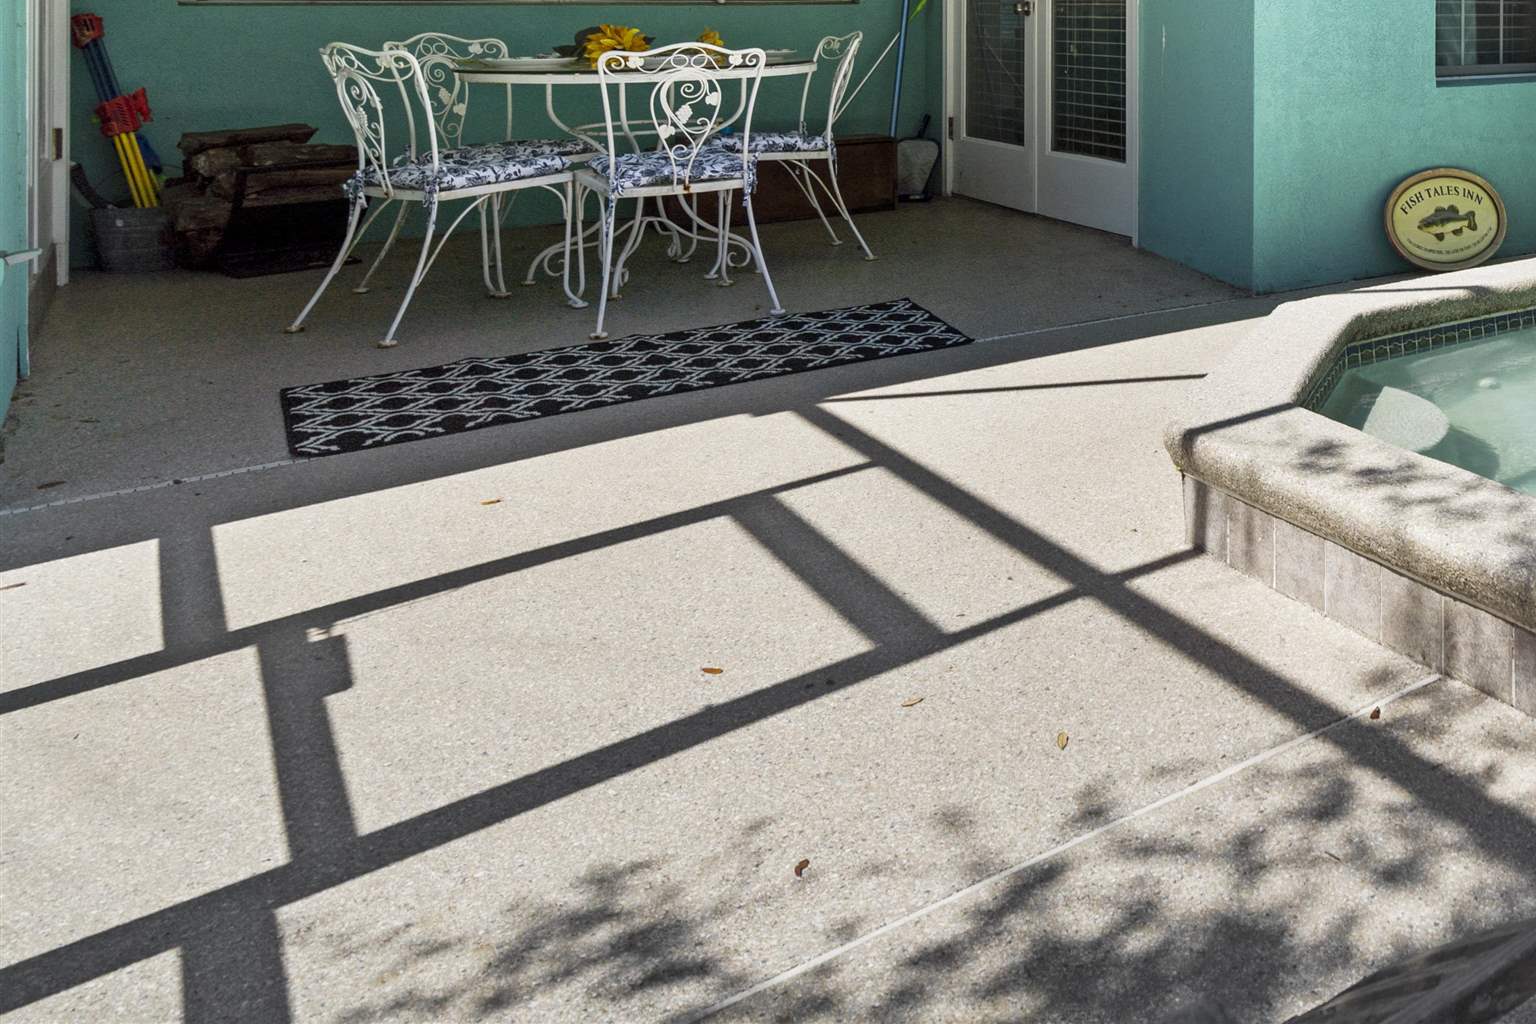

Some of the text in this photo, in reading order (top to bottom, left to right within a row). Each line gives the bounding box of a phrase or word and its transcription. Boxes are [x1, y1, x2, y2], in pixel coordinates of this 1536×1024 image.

[1400, 185, 1483, 215] FISH TALES INN
